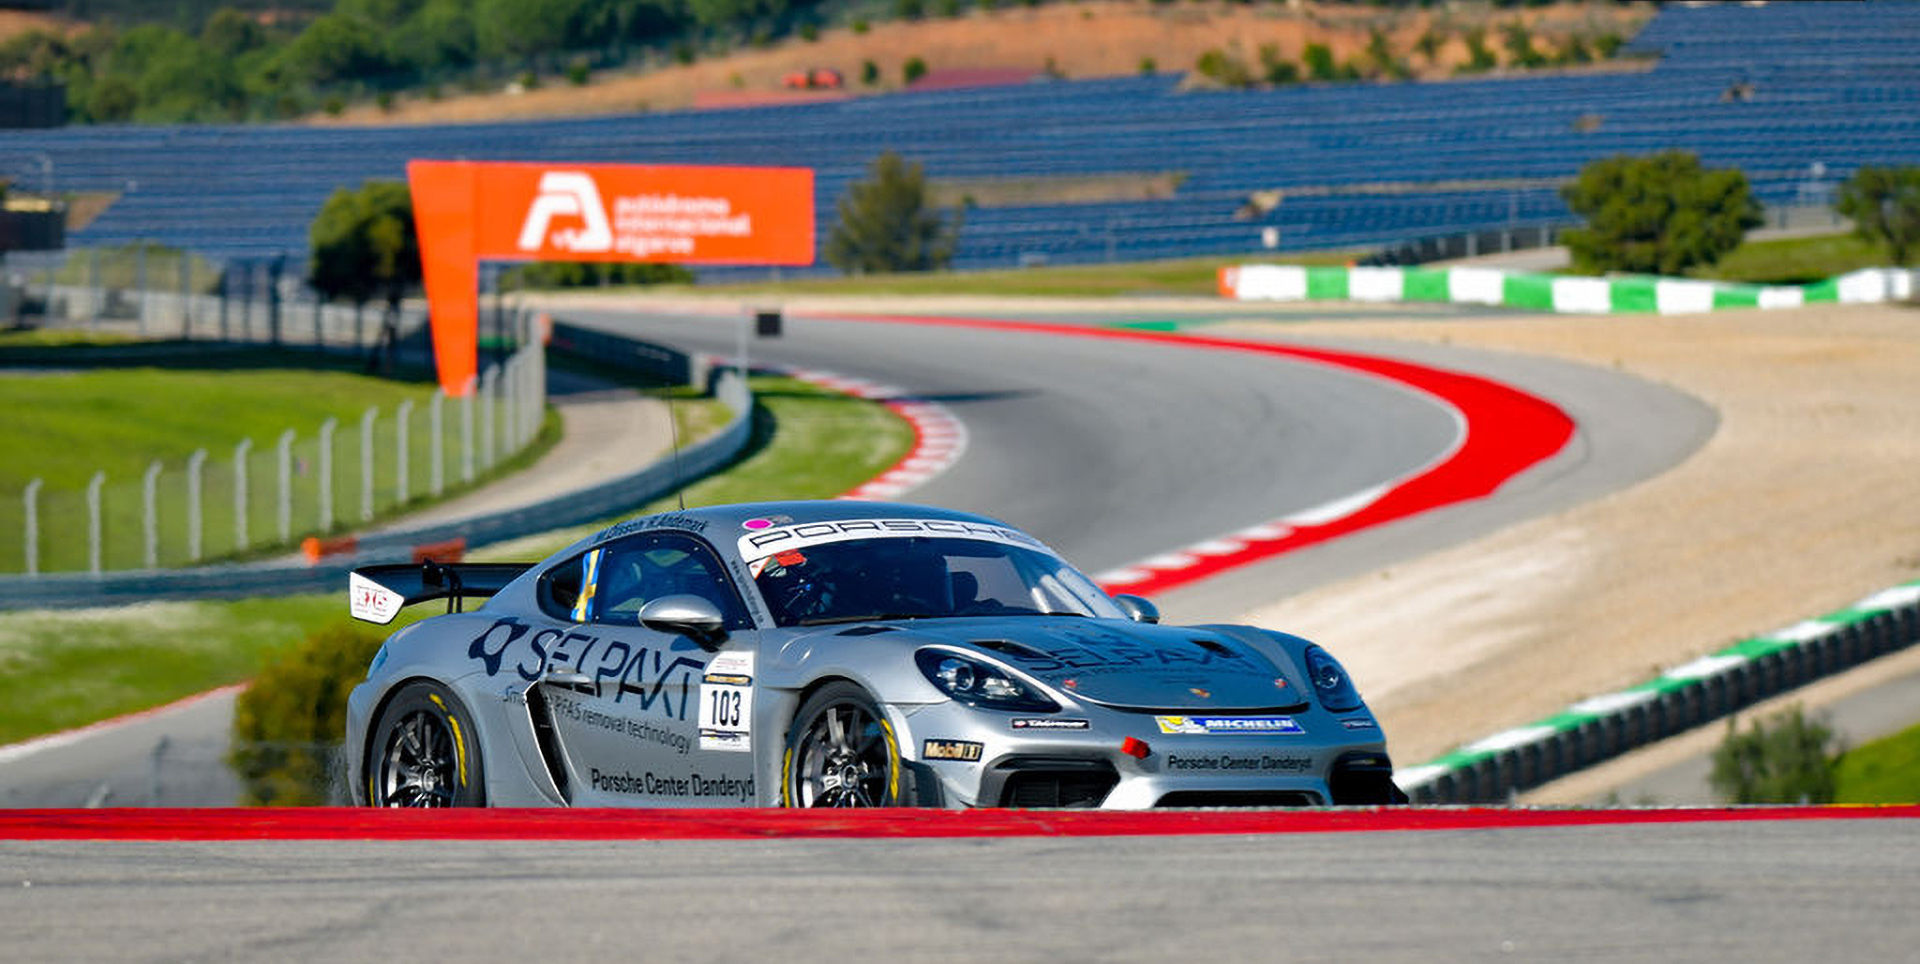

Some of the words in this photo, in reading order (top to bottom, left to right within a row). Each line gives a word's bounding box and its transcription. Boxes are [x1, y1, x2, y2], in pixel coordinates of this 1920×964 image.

[749, 520, 1041, 549] PORSCHE
[517, 629, 705, 721] SELPAXT
[711, 690, 741, 726] 103
[1205, 718, 1294, 728] MICHELIN
[582, 708, 627, 737] removal
[627, 716, 692, 754] technology
[1168, 755, 1218, 770] Porsche
[1220, 755, 1260, 770] Center
[1262, 755, 1312, 773] Danderyd
[590, 768, 644, 794] Porsche
[645, 771, 690, 796] Center
[691, 772, 756, 802] Danderyd
